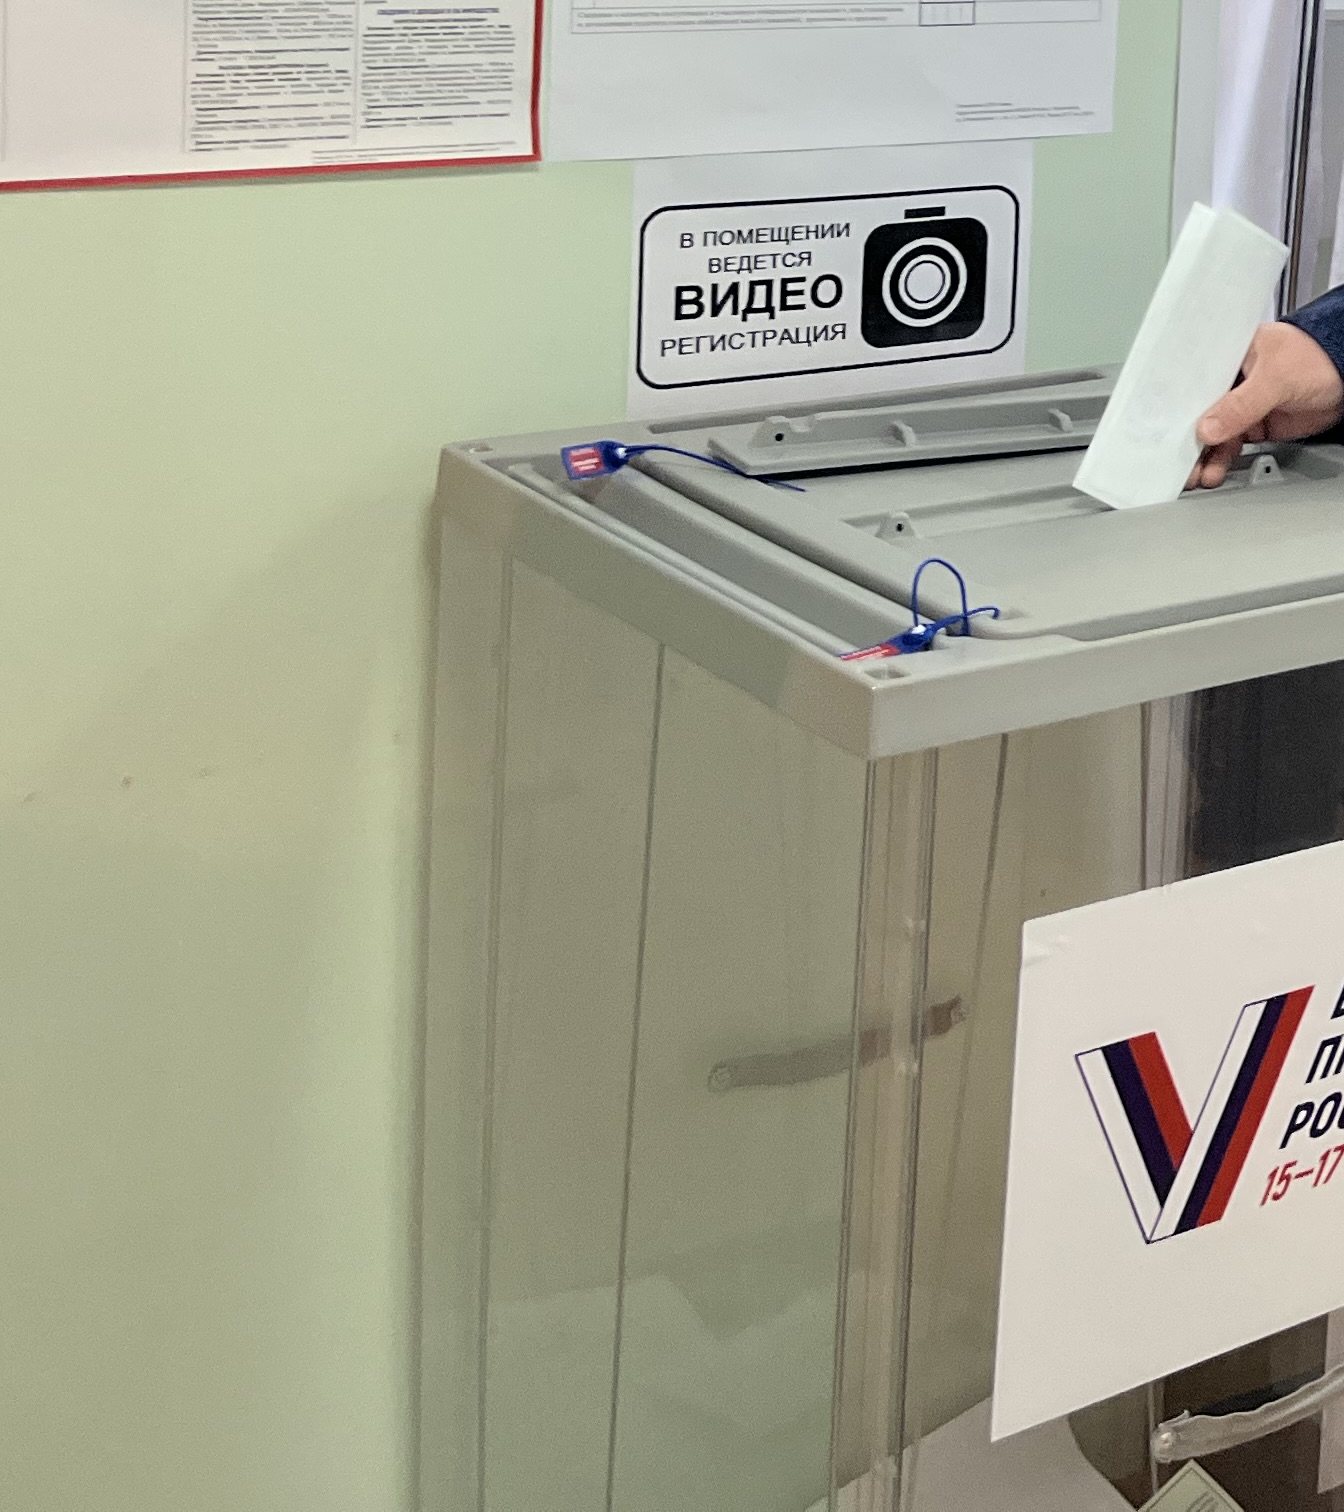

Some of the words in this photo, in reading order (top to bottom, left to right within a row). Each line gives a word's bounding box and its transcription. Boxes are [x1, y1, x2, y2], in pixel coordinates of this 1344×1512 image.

[680, 232, 694, 249] В
[702, 222, 851, 248] ПОМЕЩЕНИИ
[708, 251, 812, 275] ВЕДЕТСЯ
[674, 273, 843, 322] ВИДЕО
[661, 323, 847, 357] РЕГИСТРАЦИЯ
